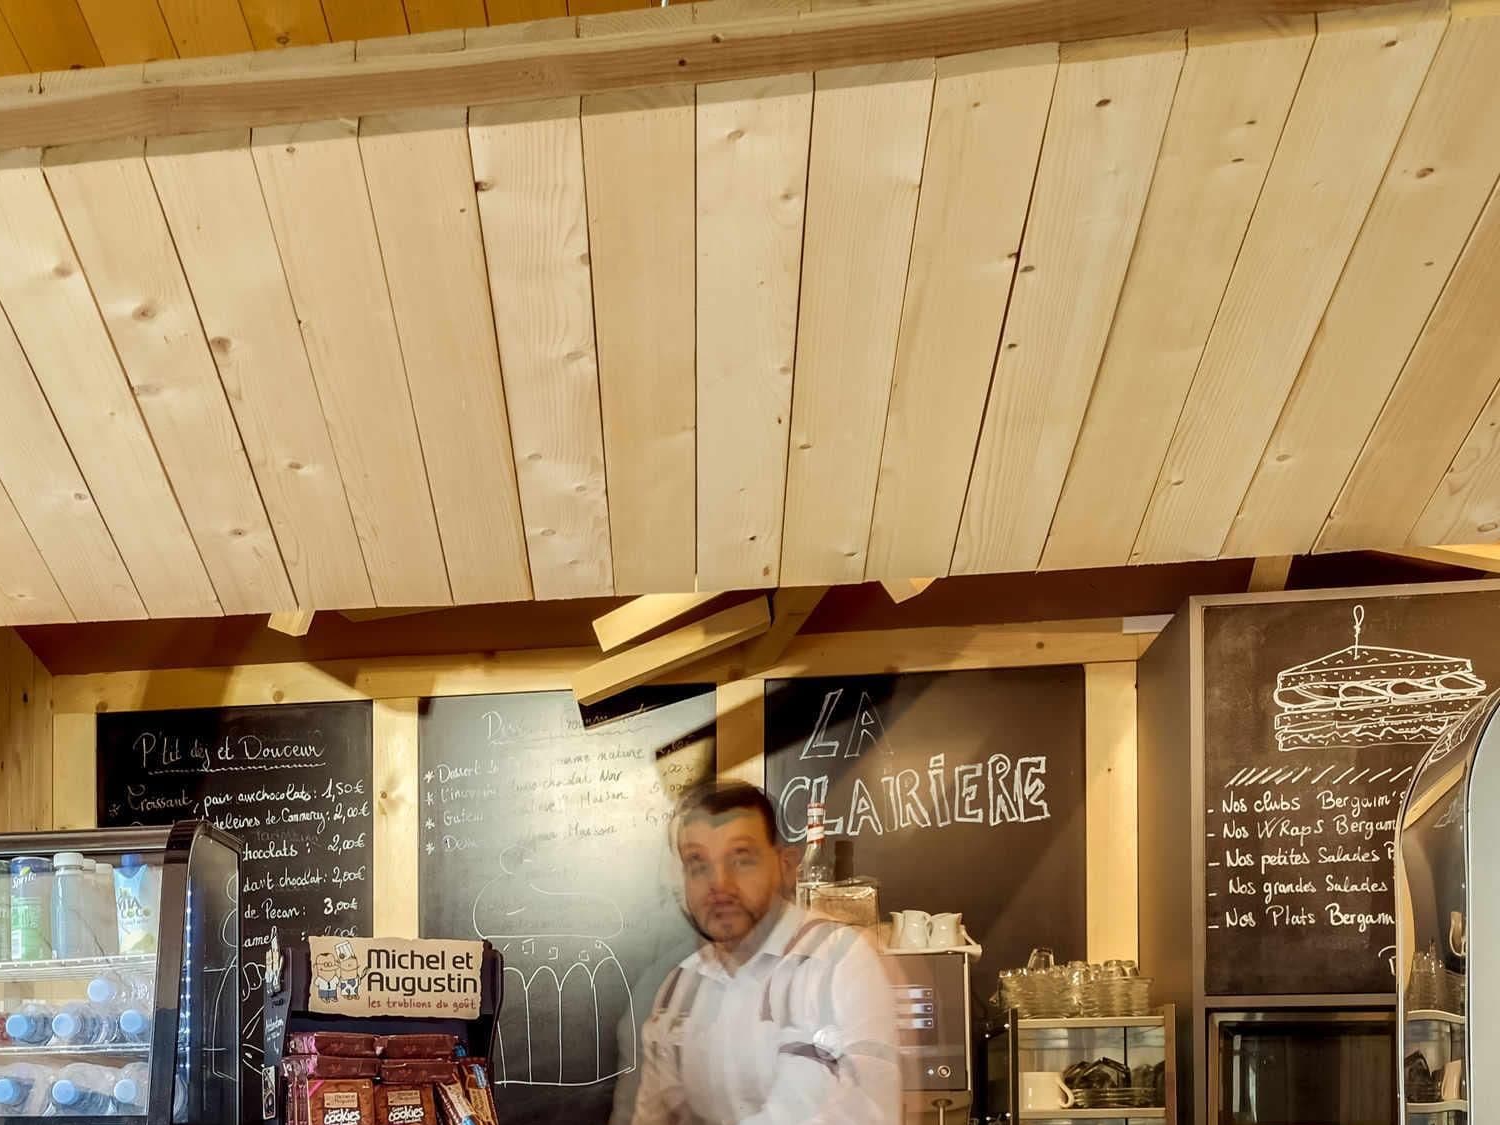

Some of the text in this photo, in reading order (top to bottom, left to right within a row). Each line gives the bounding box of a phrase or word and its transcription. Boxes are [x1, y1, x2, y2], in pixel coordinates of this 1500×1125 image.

[800, 688, 894, 760] LA
[217, 736, 234, 760] et
[1222, 790, 1248, 813] Nos
[1253, 790, 1301, 812] clubs
[1223, 819, 1249, 839] Nos
[1226, 848, 1254, 867] Nos
[1261, 847, 1310, 875] petites
[1228, 876, 1256, 895] Nos
[1263, 877, 1317, 904] grandes
[1225, 908, 1256, 928] Nos
[1266, 905, 1316, 926] Plats
[367, 949, 474, 970] Michel et
[367, 971, 478, 997] Augustin
[368, 996, 382, 1009] les
[436, 999, 449, 1009] du
